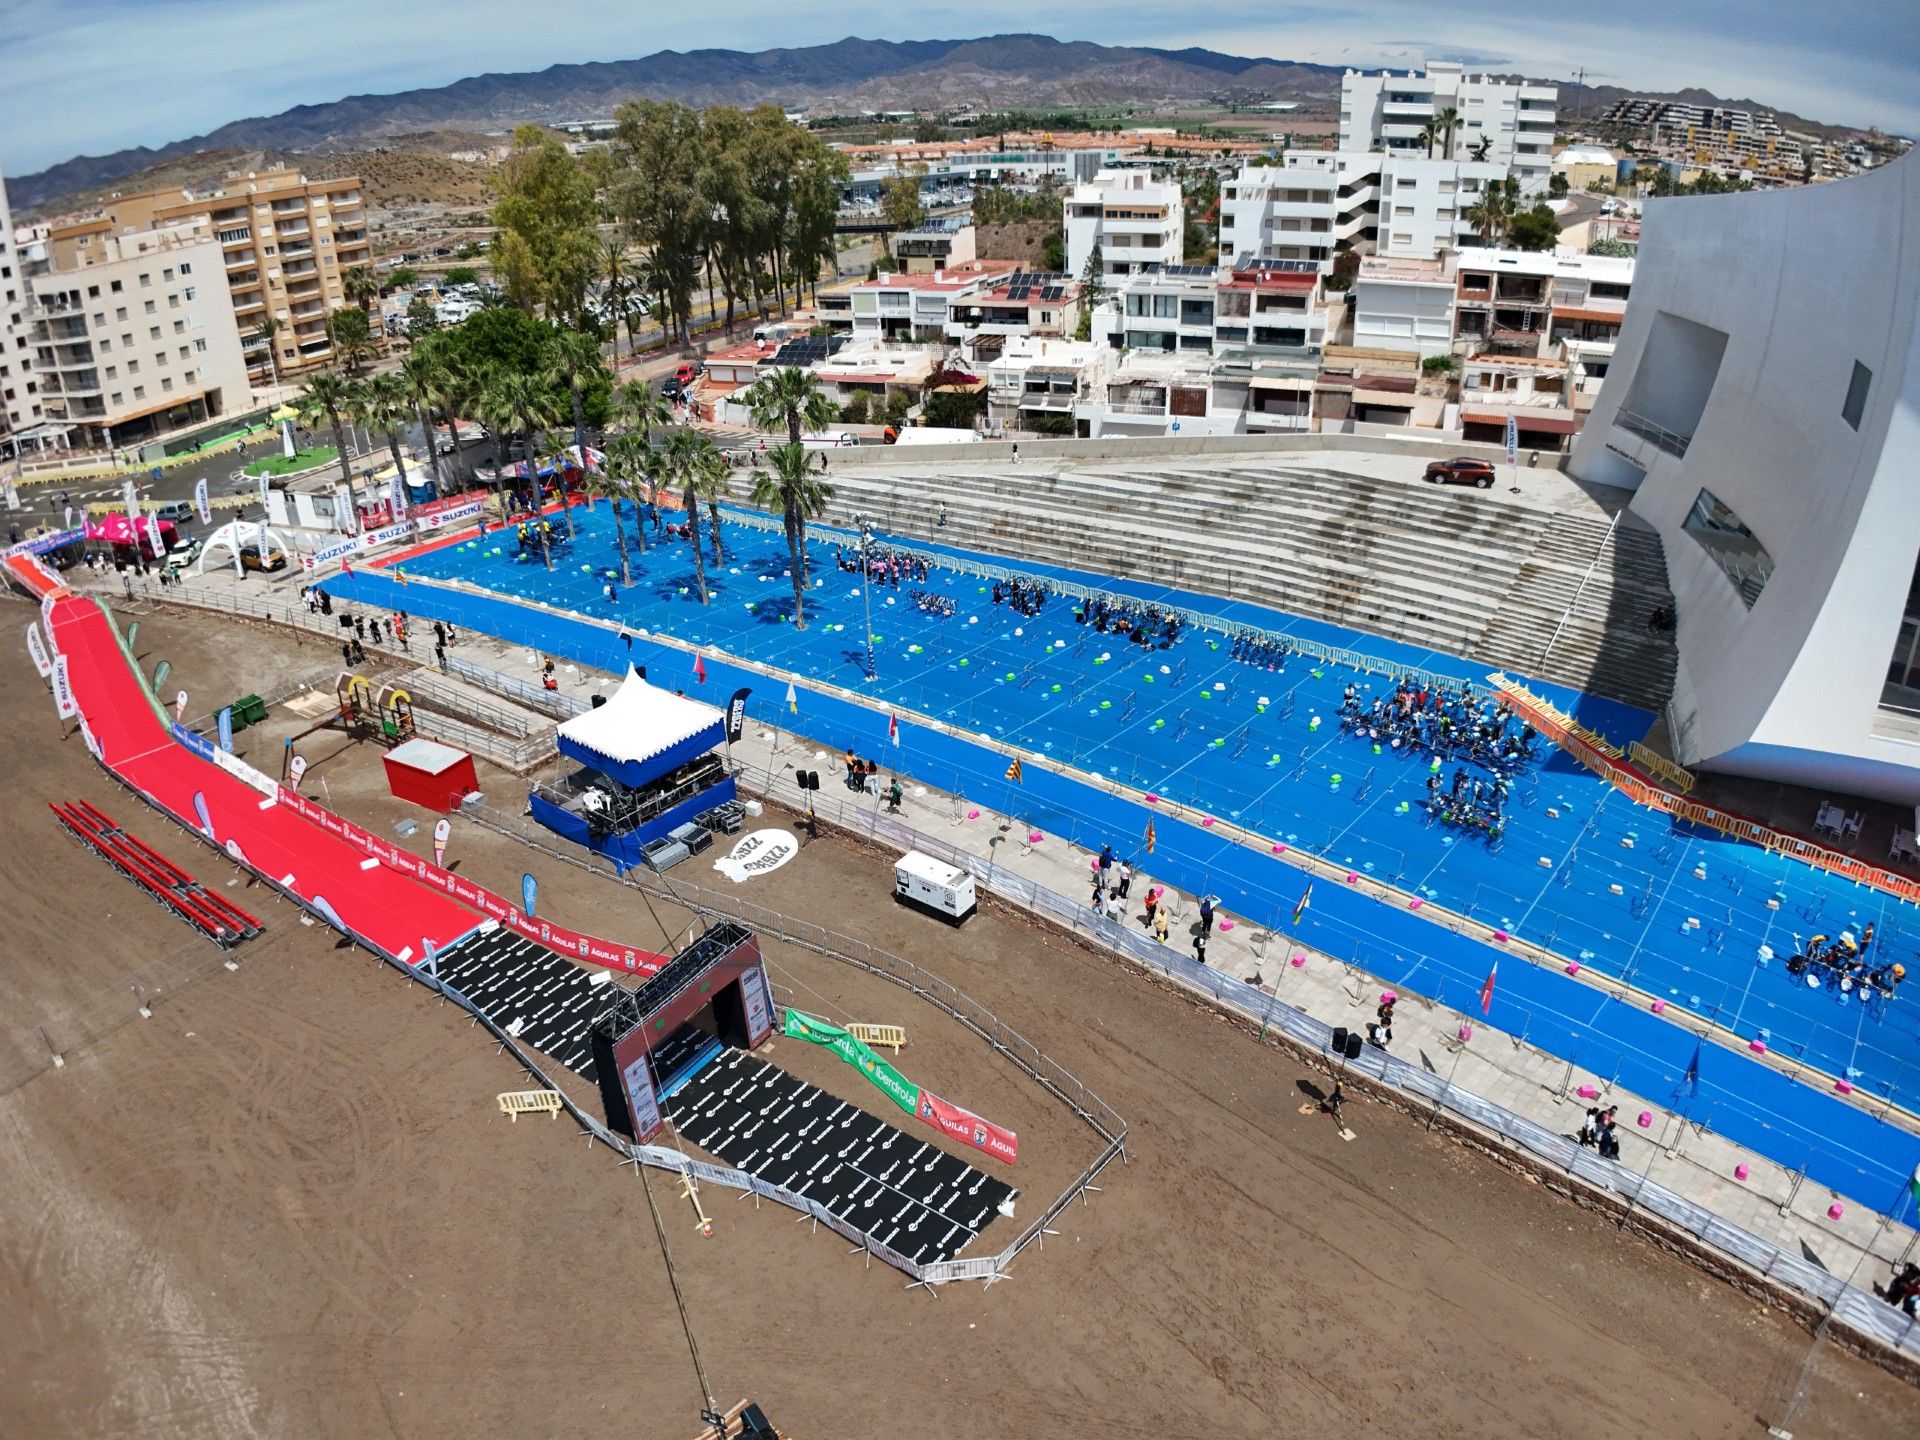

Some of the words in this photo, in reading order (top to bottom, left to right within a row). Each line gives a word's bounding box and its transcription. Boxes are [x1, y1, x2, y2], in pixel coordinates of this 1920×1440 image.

[442, 504, 481, 522] SUZUKI
[378, 524, 413, 541] SUZUK
[316, 542, 357, 563] SUZUKI
[58, 662, 68, 700] SUZUKI
[519, 918, 540, 934] ÁGUILAS
[552, 934, 576, 950] ÁGUILAS
[591, 948, 620, 962] ÁGUILAS
[938, 1116, 969, 1135] GUILAS
[990, 1138, 1016, 1156] ÁGUIL
